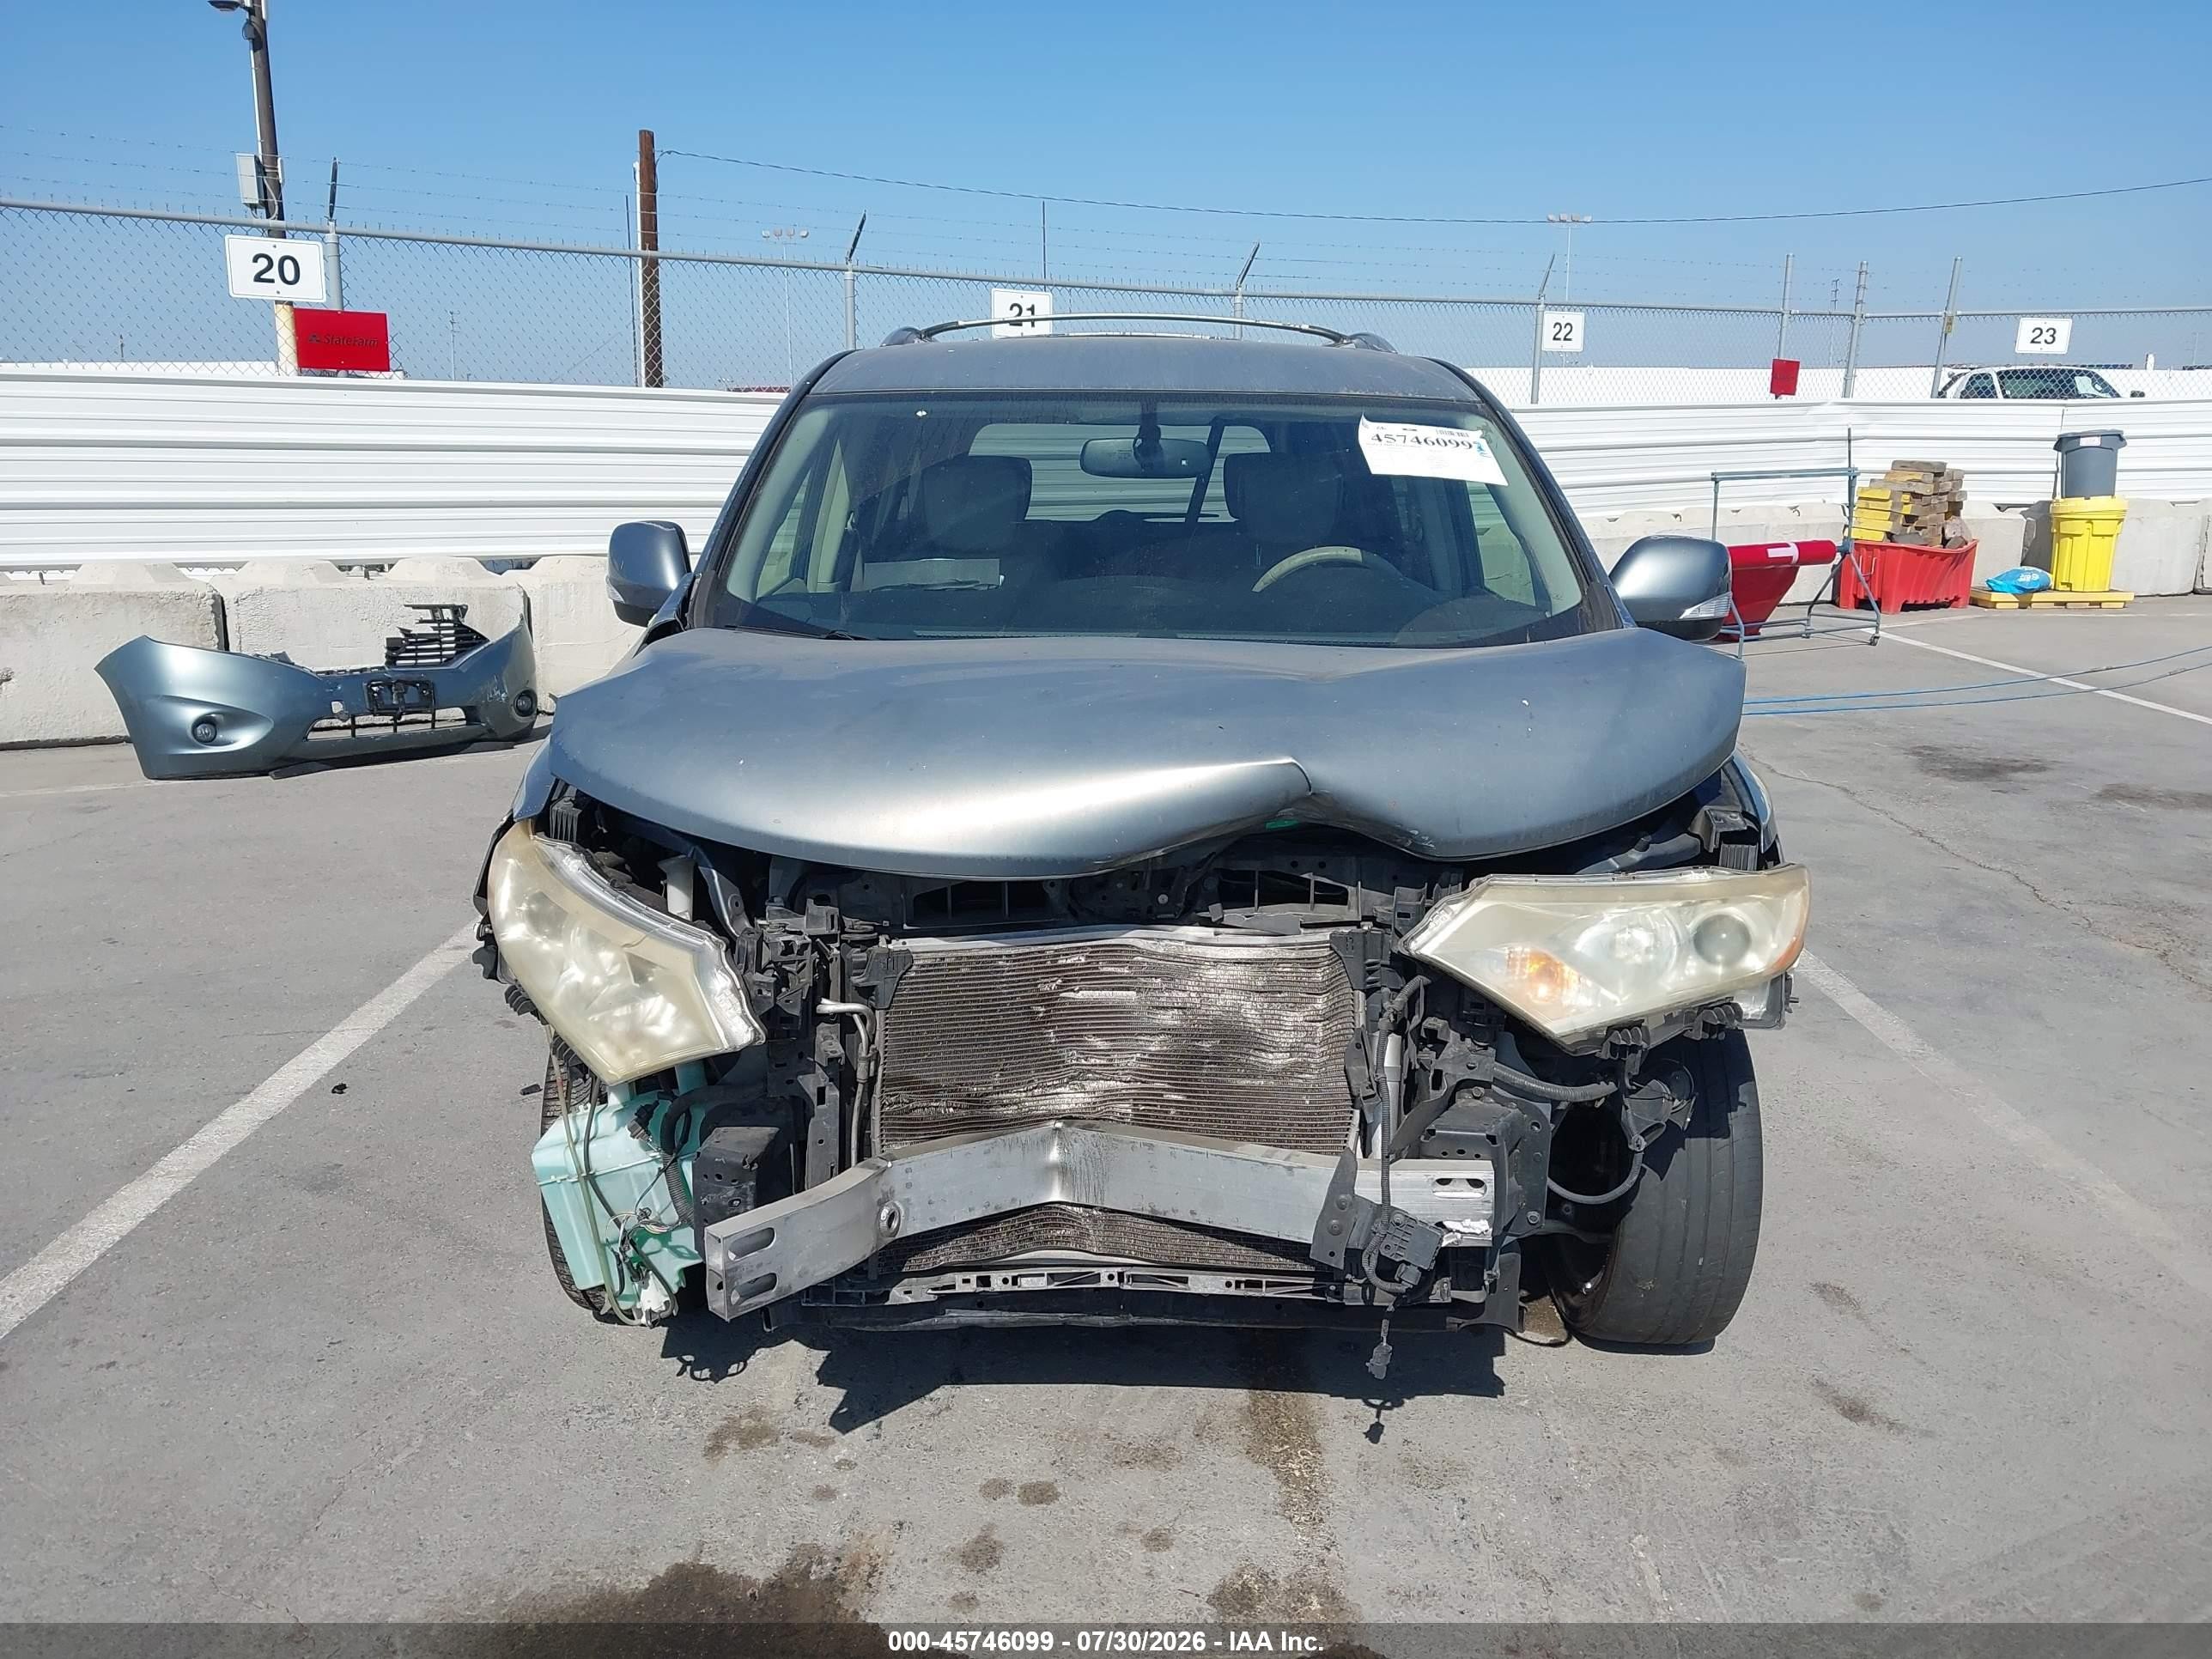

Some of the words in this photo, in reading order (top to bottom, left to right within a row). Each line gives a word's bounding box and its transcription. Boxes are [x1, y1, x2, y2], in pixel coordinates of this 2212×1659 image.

[252, 252, 301, 285] 20
[1009, 302, 1036, 328] 21
[1553, 321, 1573, 341] 22
[2030, 326, 2057, 344] 23
[1370, 433, 1474, 450] 45746099
